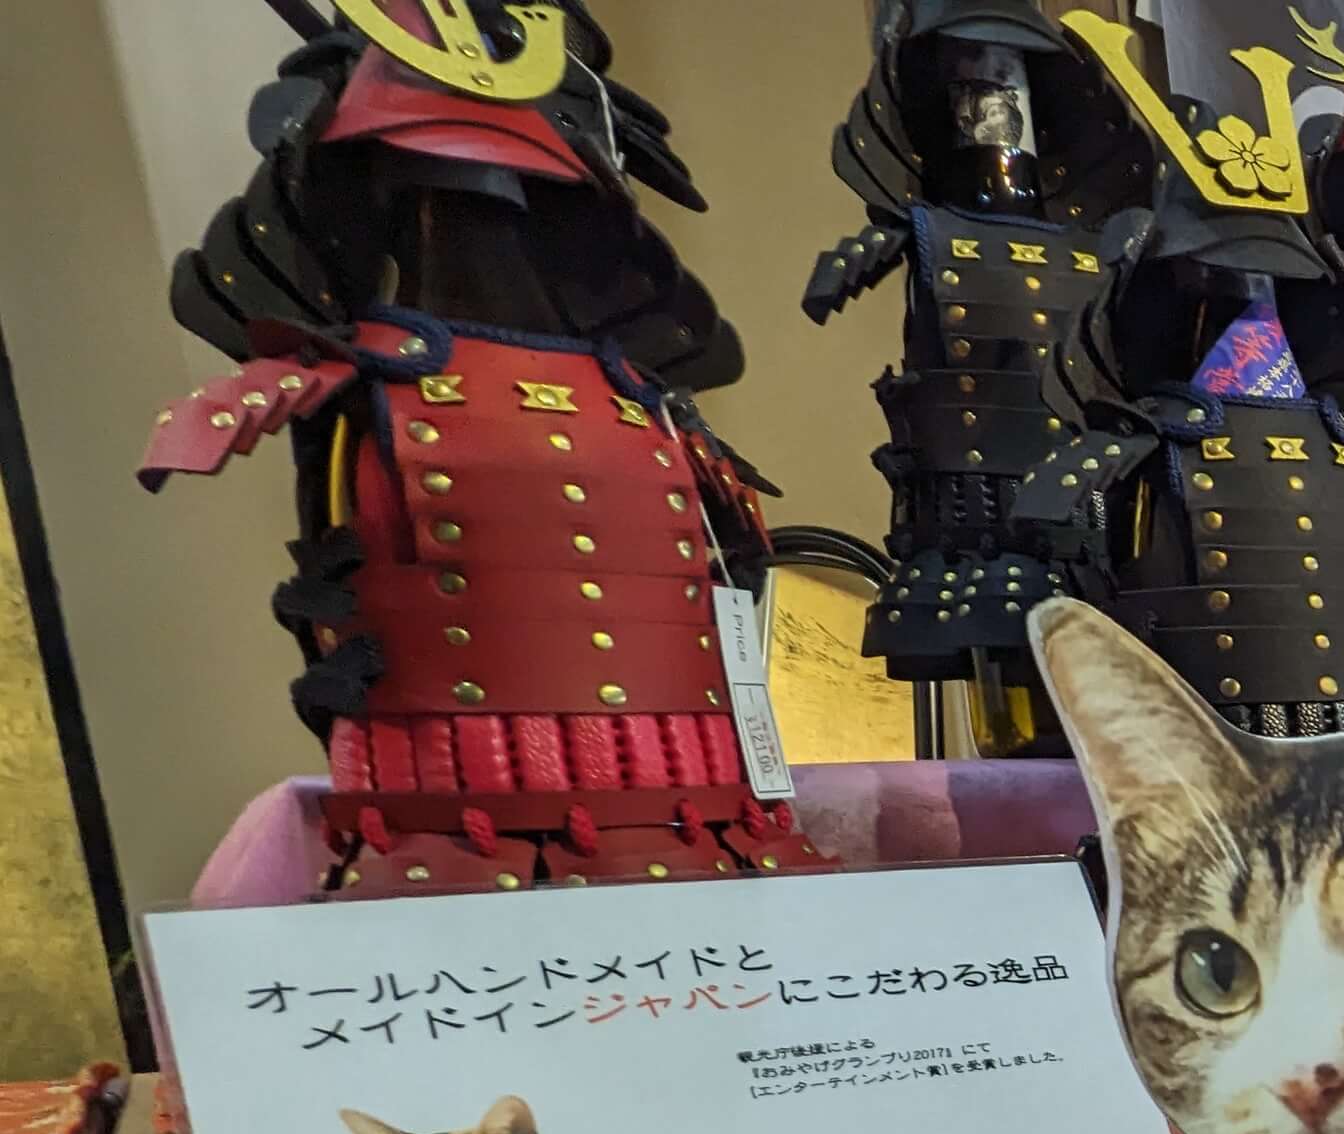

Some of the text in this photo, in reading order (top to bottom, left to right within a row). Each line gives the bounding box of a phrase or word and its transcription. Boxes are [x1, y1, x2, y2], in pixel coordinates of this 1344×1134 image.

[248, 944, 773, 1013] オールハンドメイドと
[302, 954, 1069, 1050] メイドインジャパンにこだわる逸品
